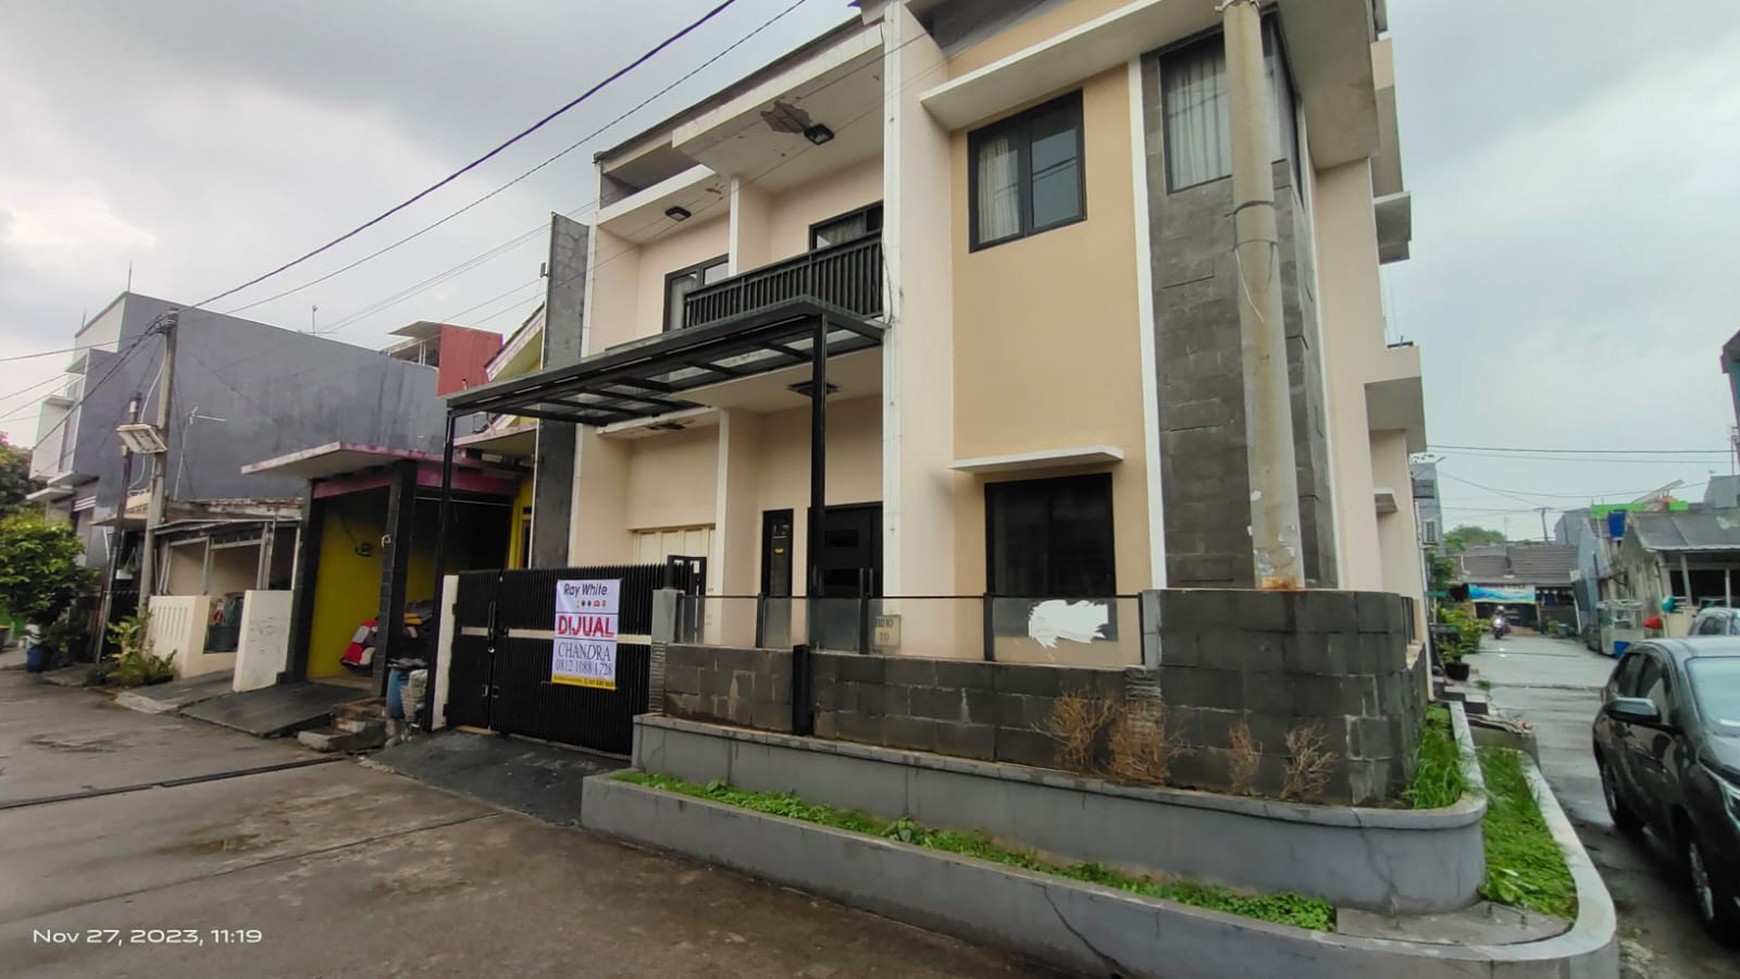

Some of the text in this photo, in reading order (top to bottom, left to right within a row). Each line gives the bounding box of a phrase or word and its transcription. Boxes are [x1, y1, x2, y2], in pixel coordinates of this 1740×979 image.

[564, 583, 608, 597] Ray White
[558, 615, 615, 638] DIJUAL
[558, 642, 611, 662] CHANDRA
[556, 659, 574, 672] 0812
